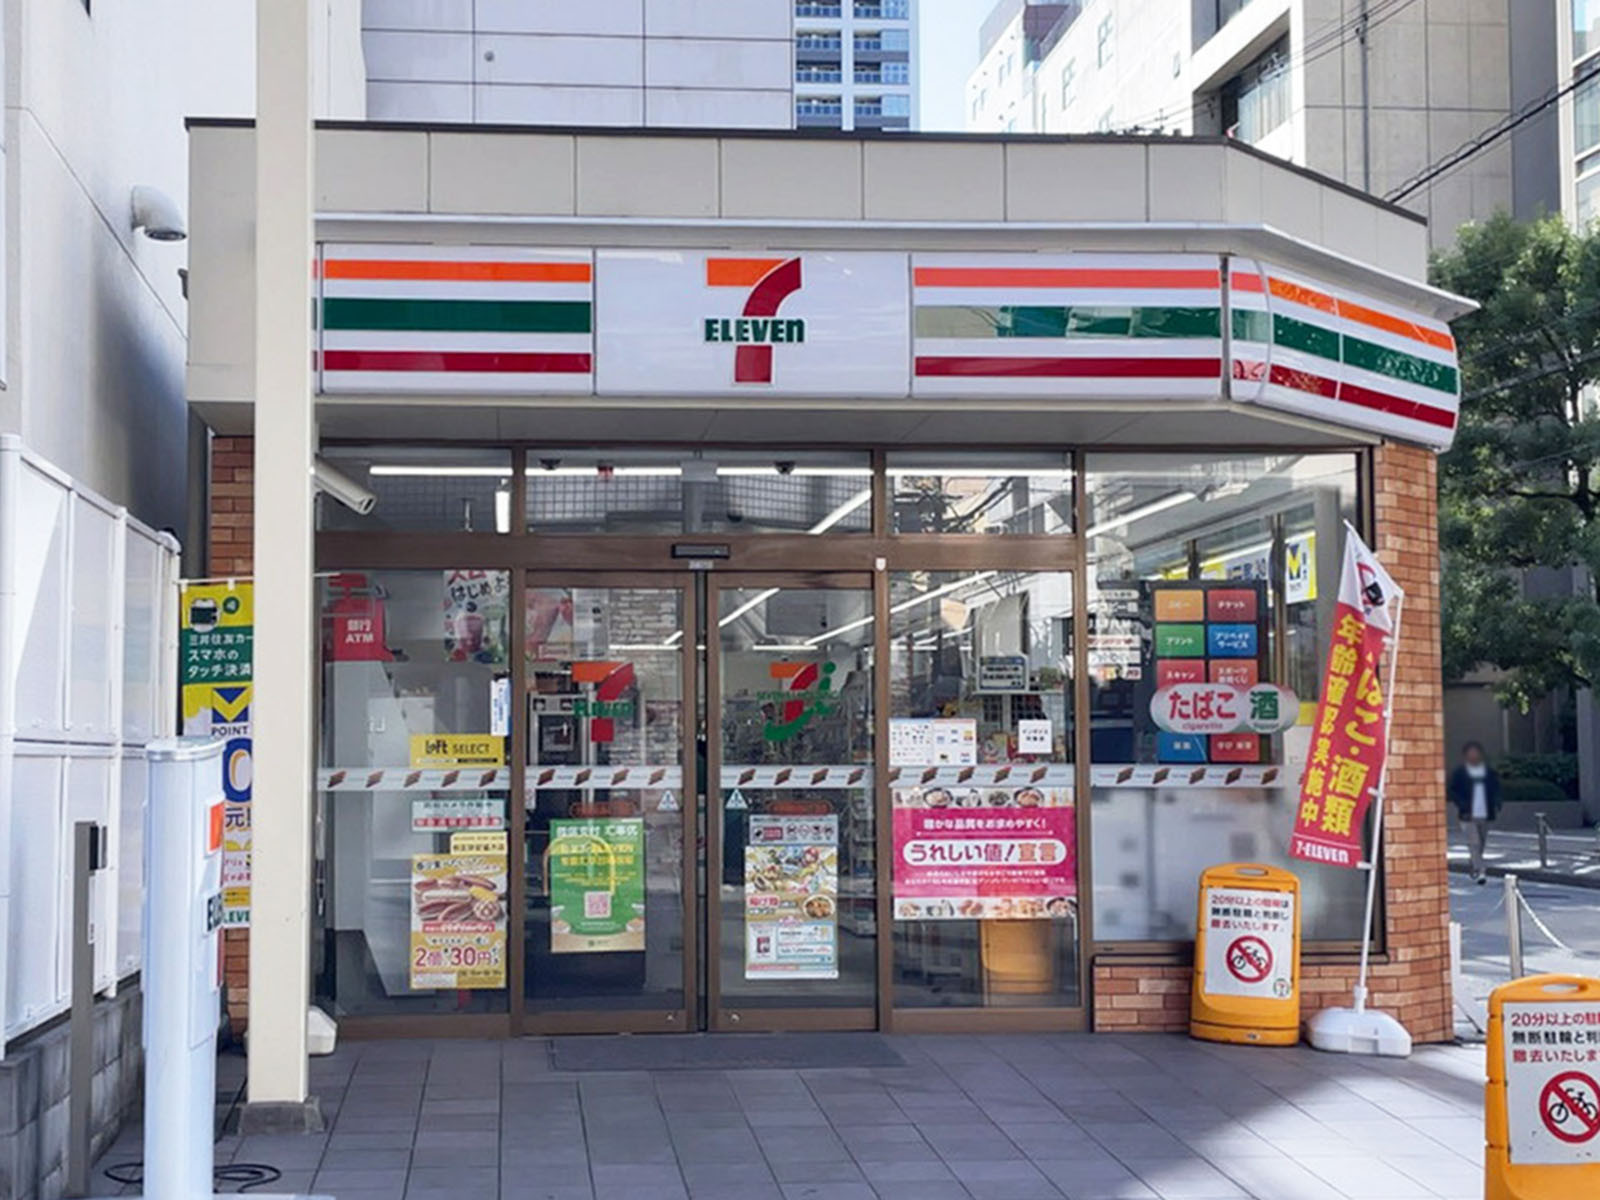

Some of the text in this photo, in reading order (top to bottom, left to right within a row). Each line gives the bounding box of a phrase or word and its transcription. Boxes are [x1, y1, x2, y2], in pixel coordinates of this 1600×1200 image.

[345, 633, 374, 644] ATM
[188, 648, 239, 661] スマホの
[1169, 690, 1237, 719] たばこ
[1250, 690, 1279, 719] 酒
[211, 725, 249, 737] POINT
[452, 743, 490, 754] SELECT
[1511, 1012, 1600, 1027] 20分以上の駐
[1513, 1050, 1600, 1063] 撤去いたしま
